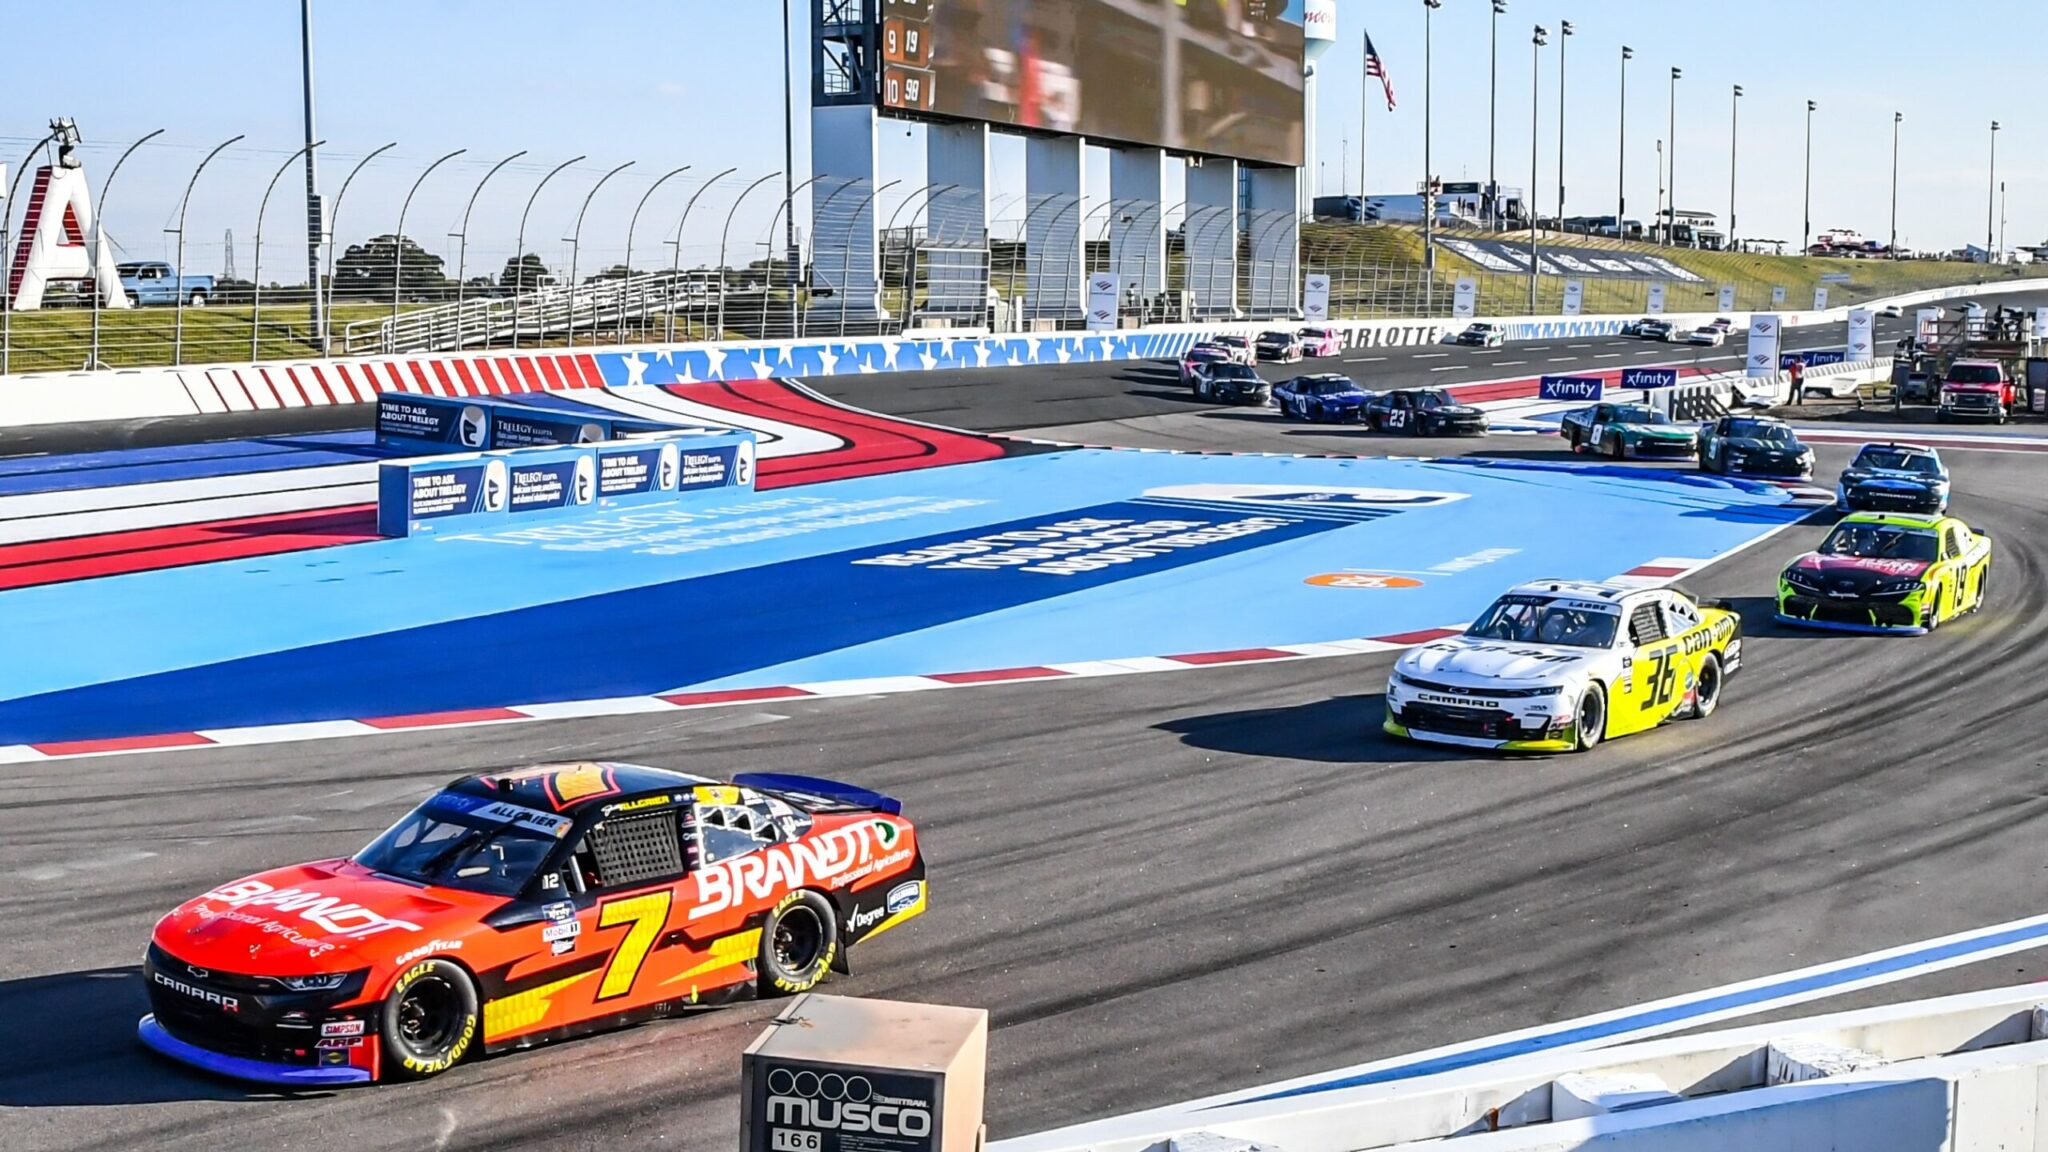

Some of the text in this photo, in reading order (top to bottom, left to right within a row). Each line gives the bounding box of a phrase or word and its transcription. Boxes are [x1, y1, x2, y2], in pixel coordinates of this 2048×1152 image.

[888, 30, 919, 54] 9 19
[887, 78, 920, 104] 10 98
[1546, 379, 1596, 398] xfinity
[1626, 371, 1671, 386] xfinity
[381, 403, 427, 416] TIME TO ASK
[381, 412, 440, 426] ABOUT TRELEGY
[1389, 408, 1406, 428] 23
[497, 420, 533, 434] TRELEGY
[432, 475, 442, 486] TO
[442, 473, 455, 485] ASK
[851, 517, 1135, 567] READY TO ASK
[927, 519, 1211, 570] YOUR DOCTOR
[1018, 544, 1173, 576] ABOUT
[1417, 692, 1500, 708] CAMARO
[542, 872, 560, 890] 12
[688, 819, 873, 920] BRANDT
[204, 880, 424, 938] BRANDT
[772, 889, 805, 918] EAGLE
[856, 906, 885, 928] Degree
[597, 890, 673, 1000] 7
[395, 961, 436, 994] EAGLE
[324, 1024, 361, 1035] SIMPSON
[403, 1013, 477, 1073] GOODYEAR
